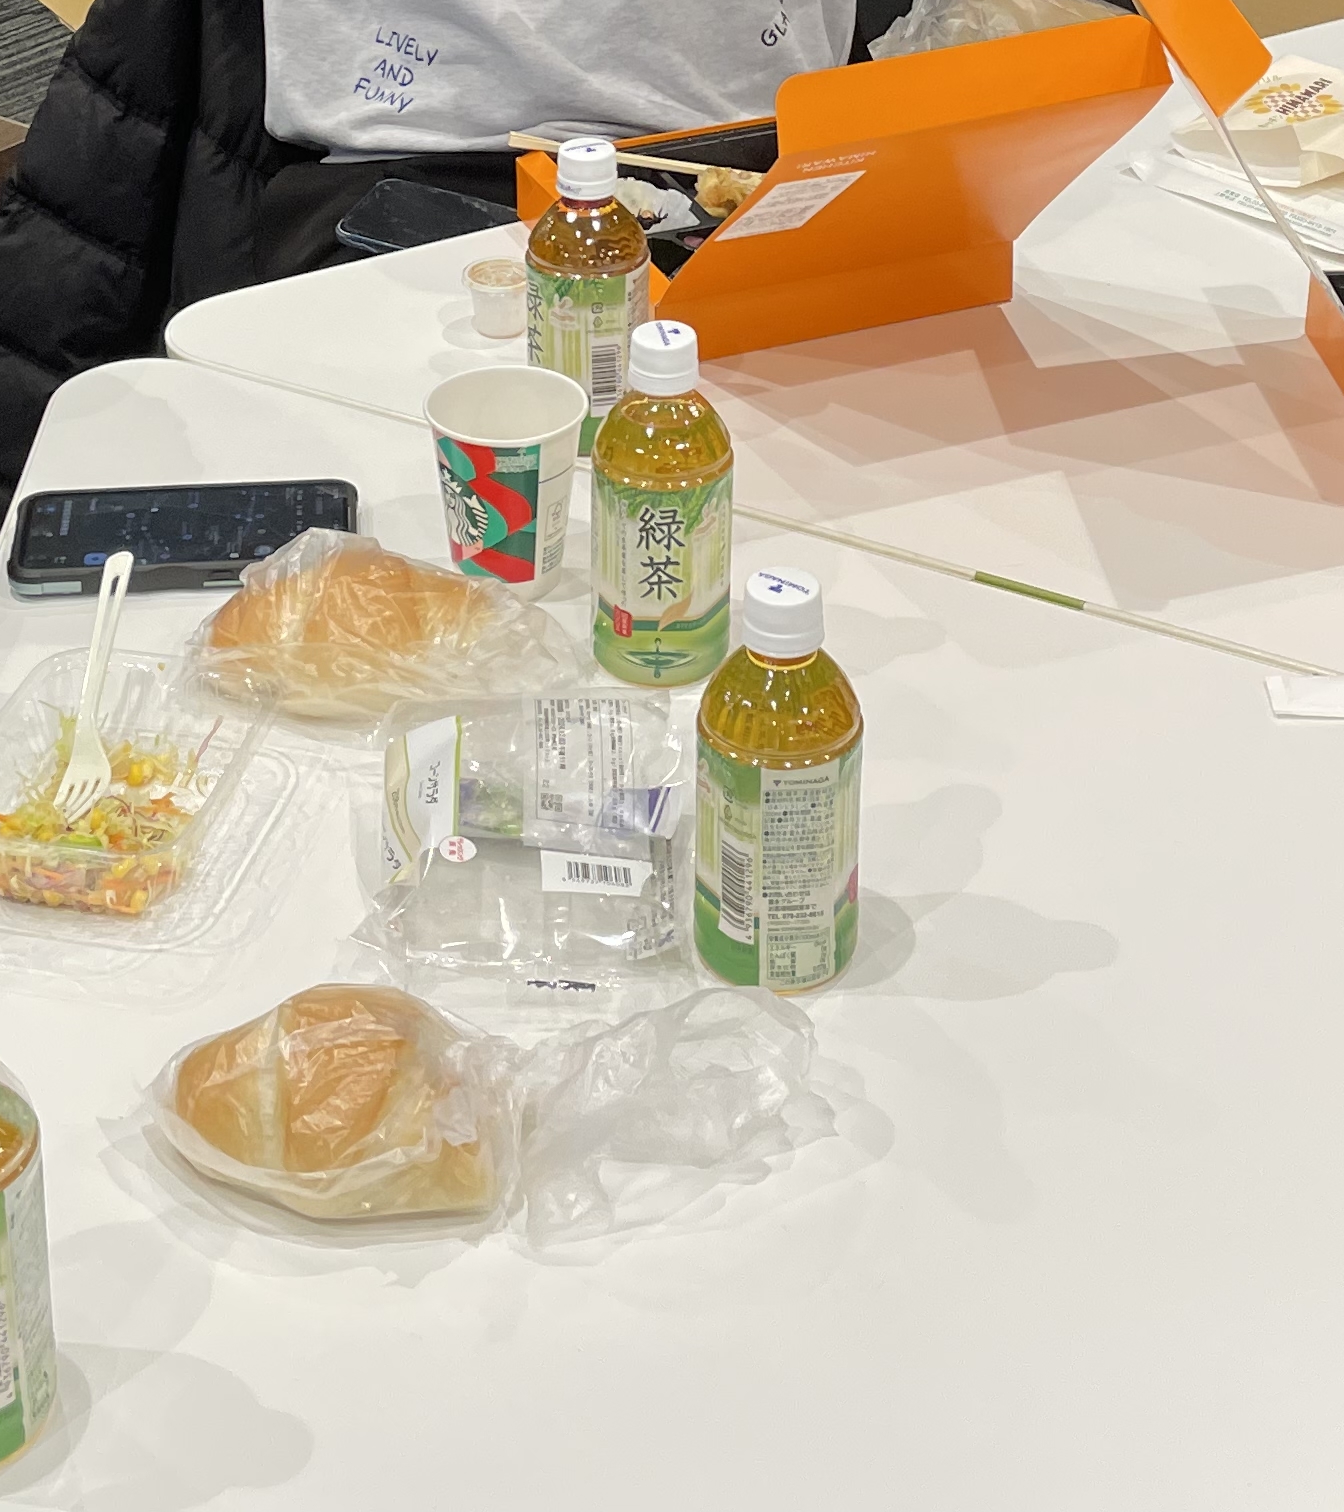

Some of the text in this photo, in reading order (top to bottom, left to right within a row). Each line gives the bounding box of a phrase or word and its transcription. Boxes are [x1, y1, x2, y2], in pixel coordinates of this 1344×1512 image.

[375, 26, 439, 67] LIVELY
[373, 58, 414, 87] AND
[353, 77, 414, 114] FUNNY
[1275, 77, 1333, 117] HIMAWARI
[635, 506, 686, 600] 緑茶
[783, 776, 830, 785] TOMINAGA
